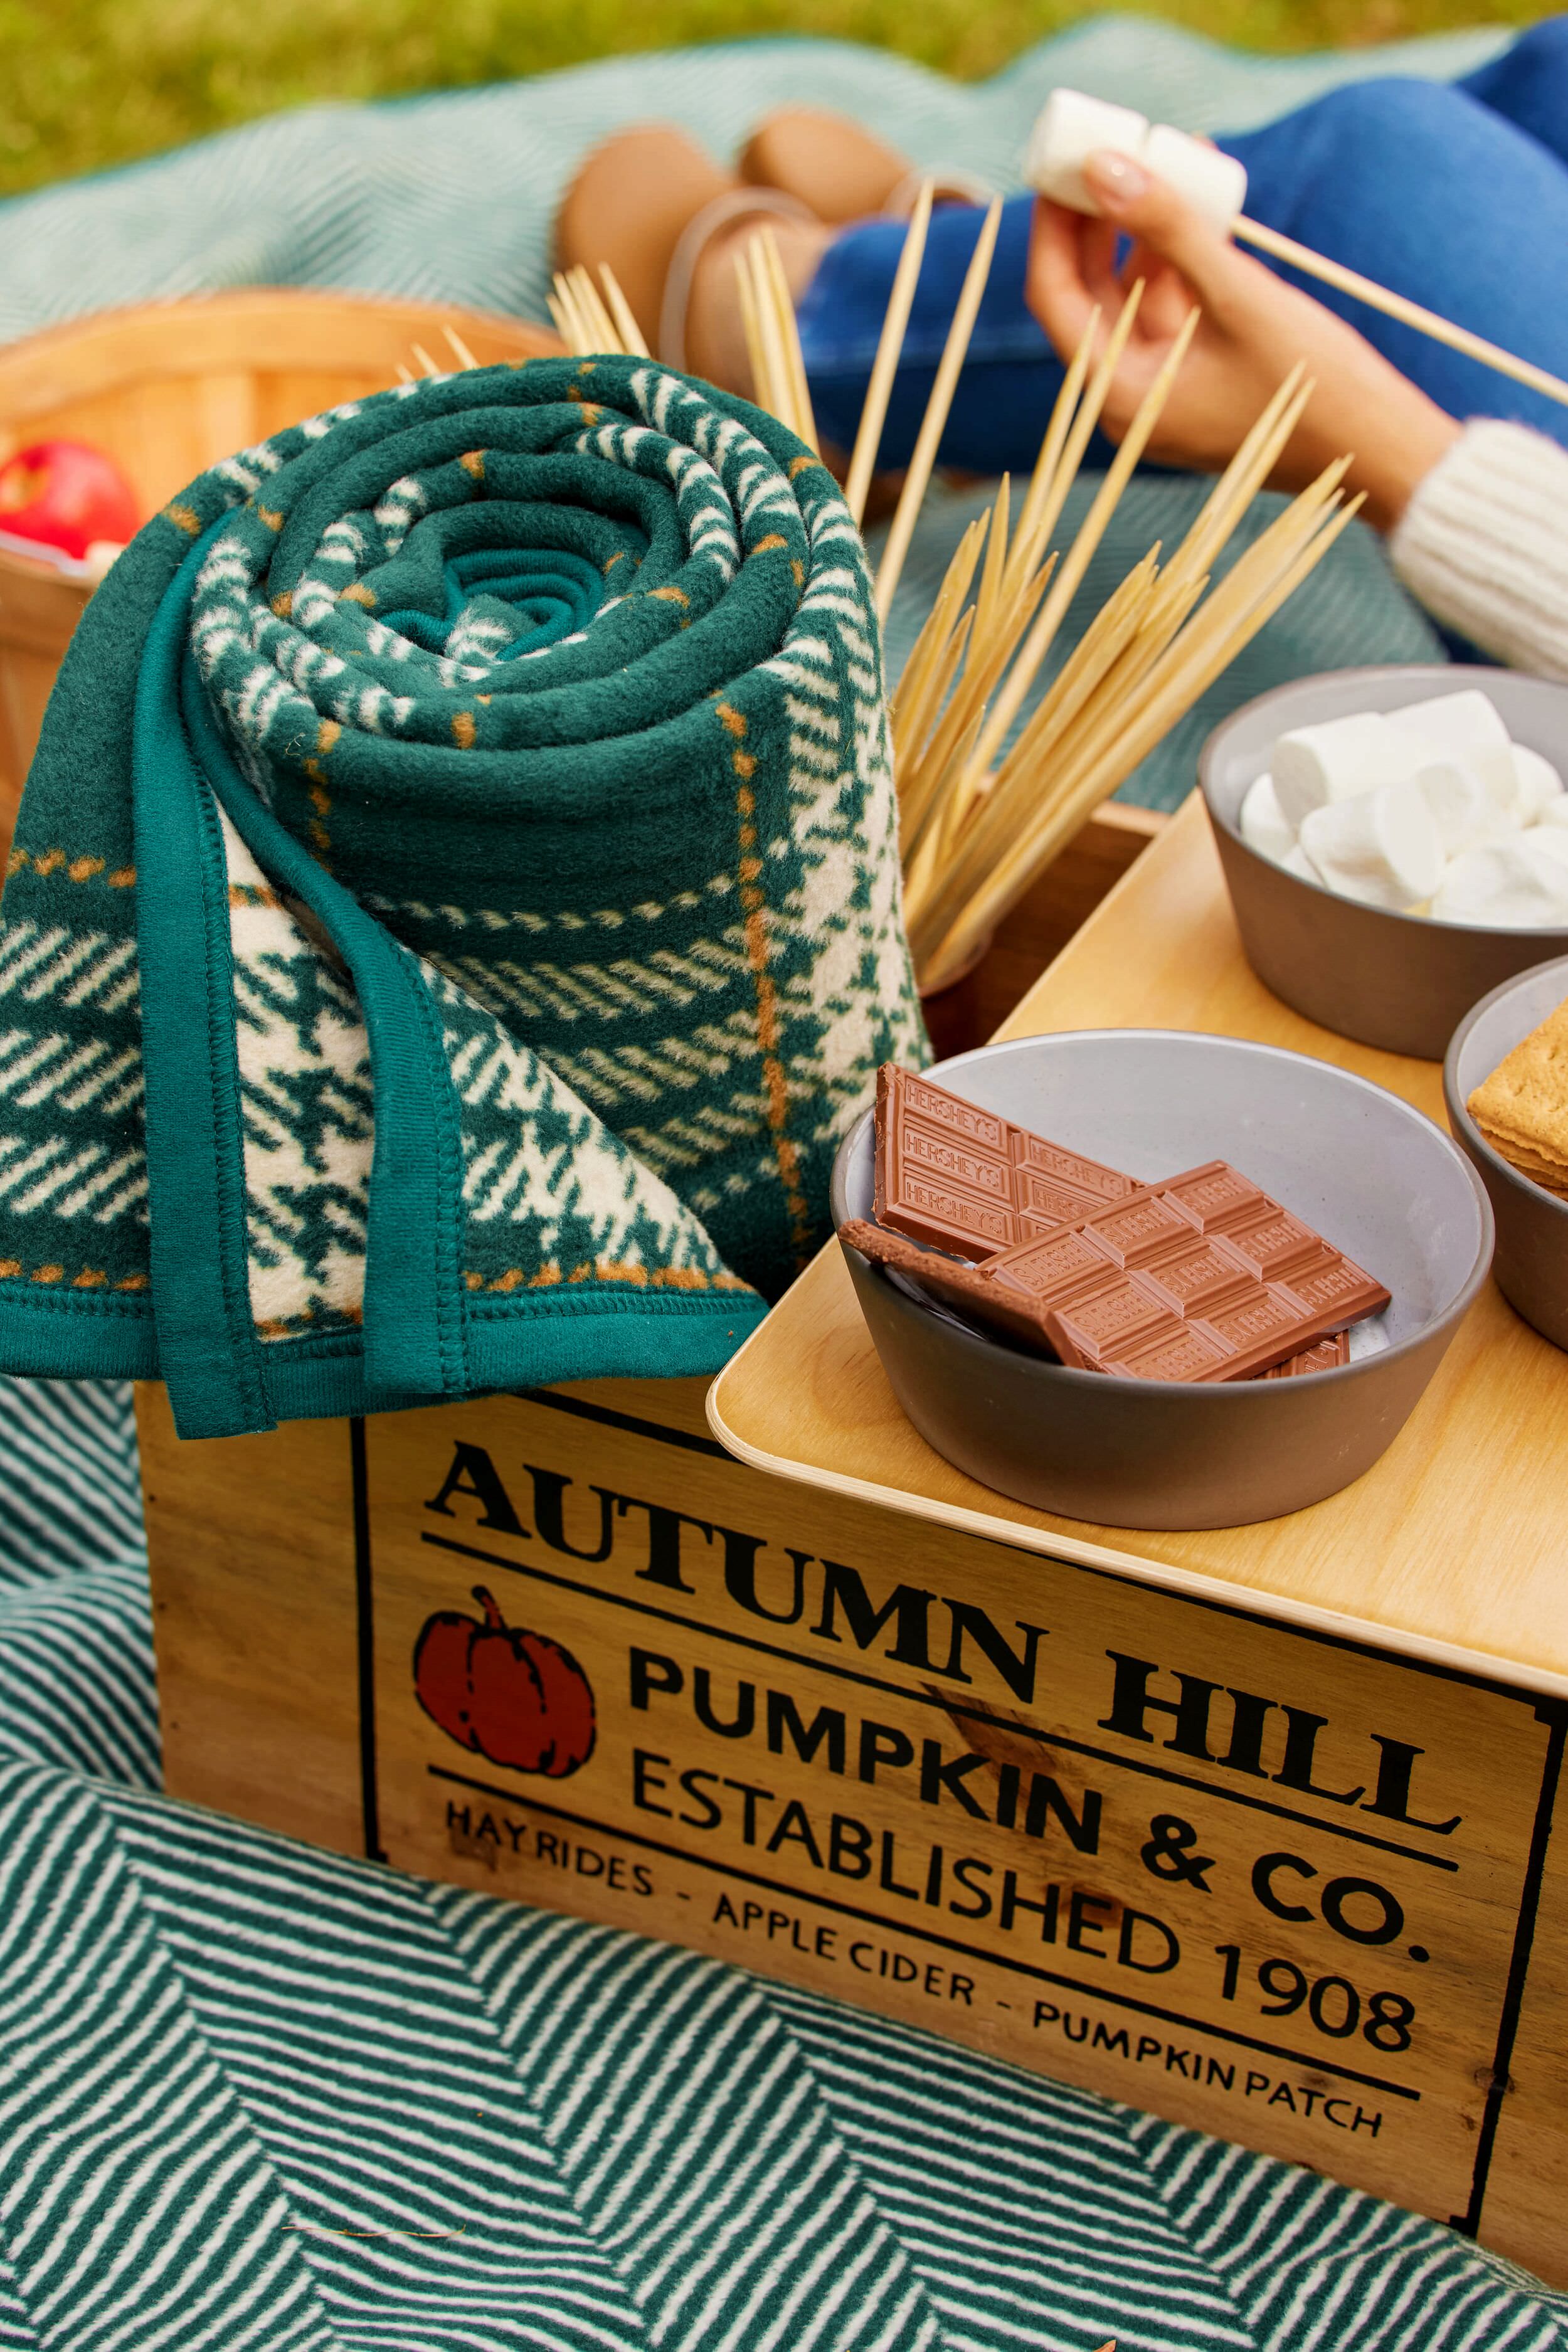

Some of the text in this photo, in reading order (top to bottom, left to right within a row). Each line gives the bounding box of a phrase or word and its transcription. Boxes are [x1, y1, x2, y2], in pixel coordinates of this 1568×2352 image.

[906, 1133, 999, 1187] HERSHEY'S
[907, 1182, 1002, 1234] HERSHEY'S
[908, 1084, 997, 1141] HERSHEY'S
[424, 1440, 1462, 1835] AUTUMN HILL
[630, 1647, 1430, 1963] PUMPKIN & CO.
[633, 1749, 1415, 2052] ESTABLISHED 1908
[713, 1894, 836, 1960] APPLE
[850, 1942, 974, 2005] CIDER
[1034, 2001, 1235, 2090] PUMPKIN
[1246, 2072, 1382, 2137] PATCH
